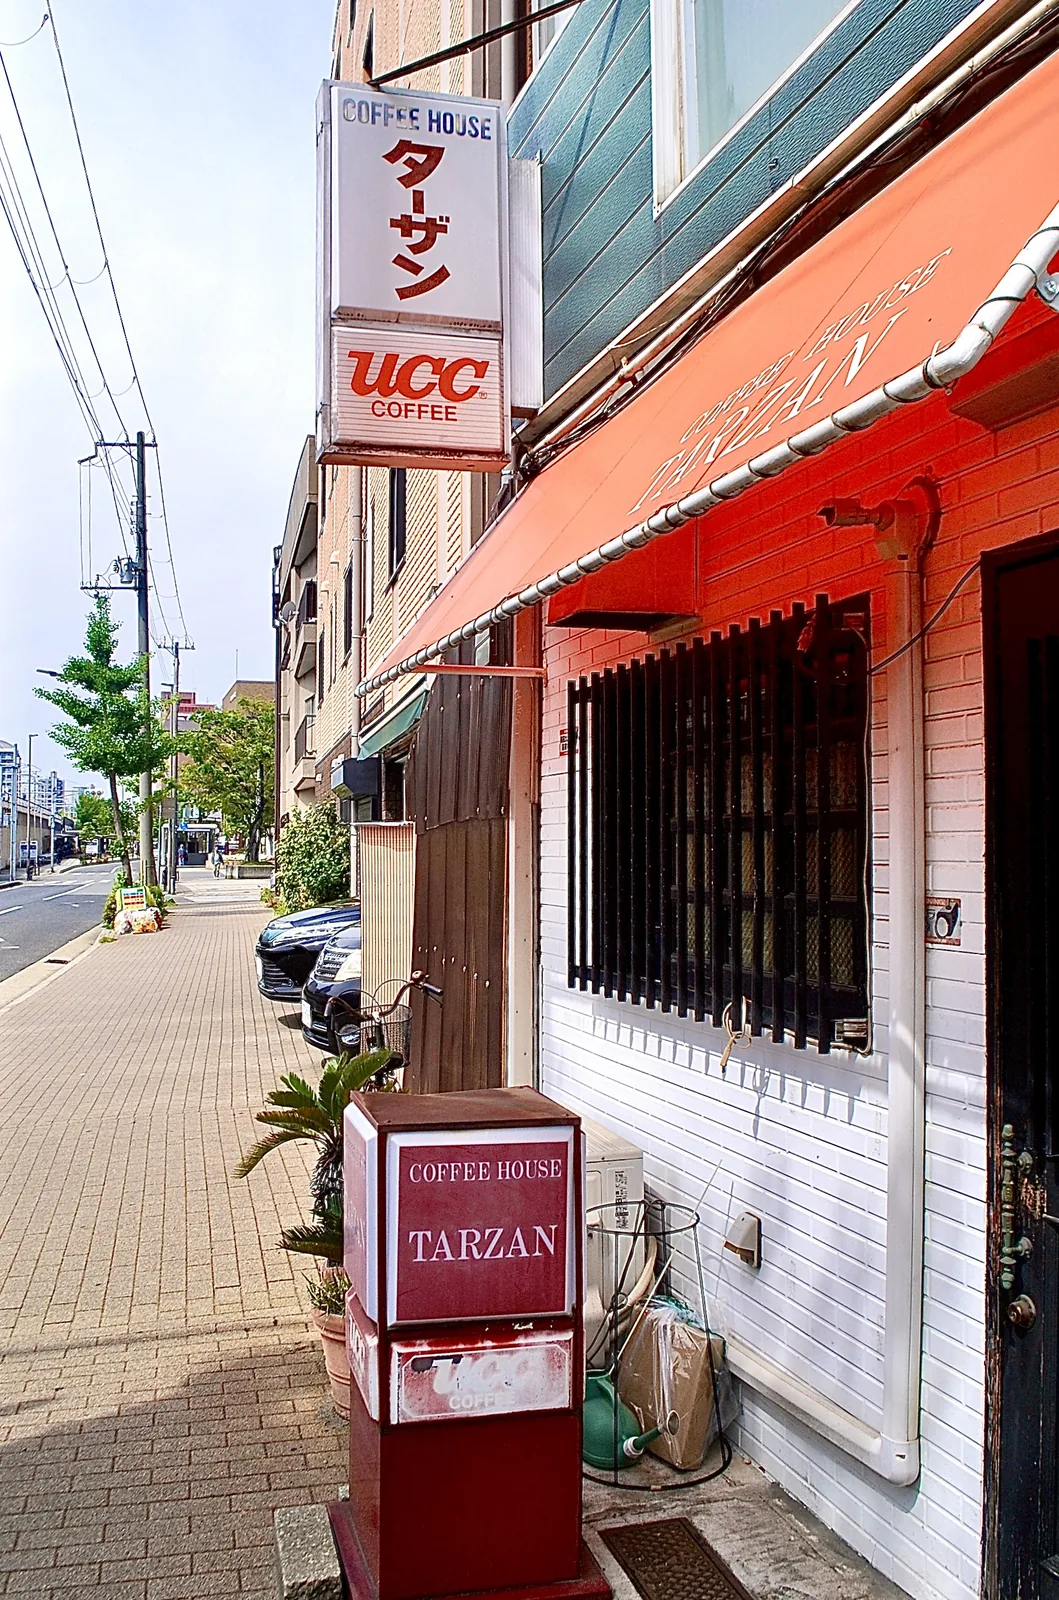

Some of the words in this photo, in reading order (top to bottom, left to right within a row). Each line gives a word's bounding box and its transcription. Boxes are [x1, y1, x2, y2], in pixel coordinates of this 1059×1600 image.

[342, 98, 420, 131] COFFEE
[427, 108, 493, 141] HOUSE
[382, 138, 451, 301] ターザン
[802, 246, 953, 363] HOUSE
[371, 400, 458, 422] COFFEE
[627, 307, 909, 516] TARZAN
[409, 1161, 491, 1184] COFFEE
[496, 1158, 563, 1181] HOUSE
[408, 1224, 559, 1263] TARZAN
